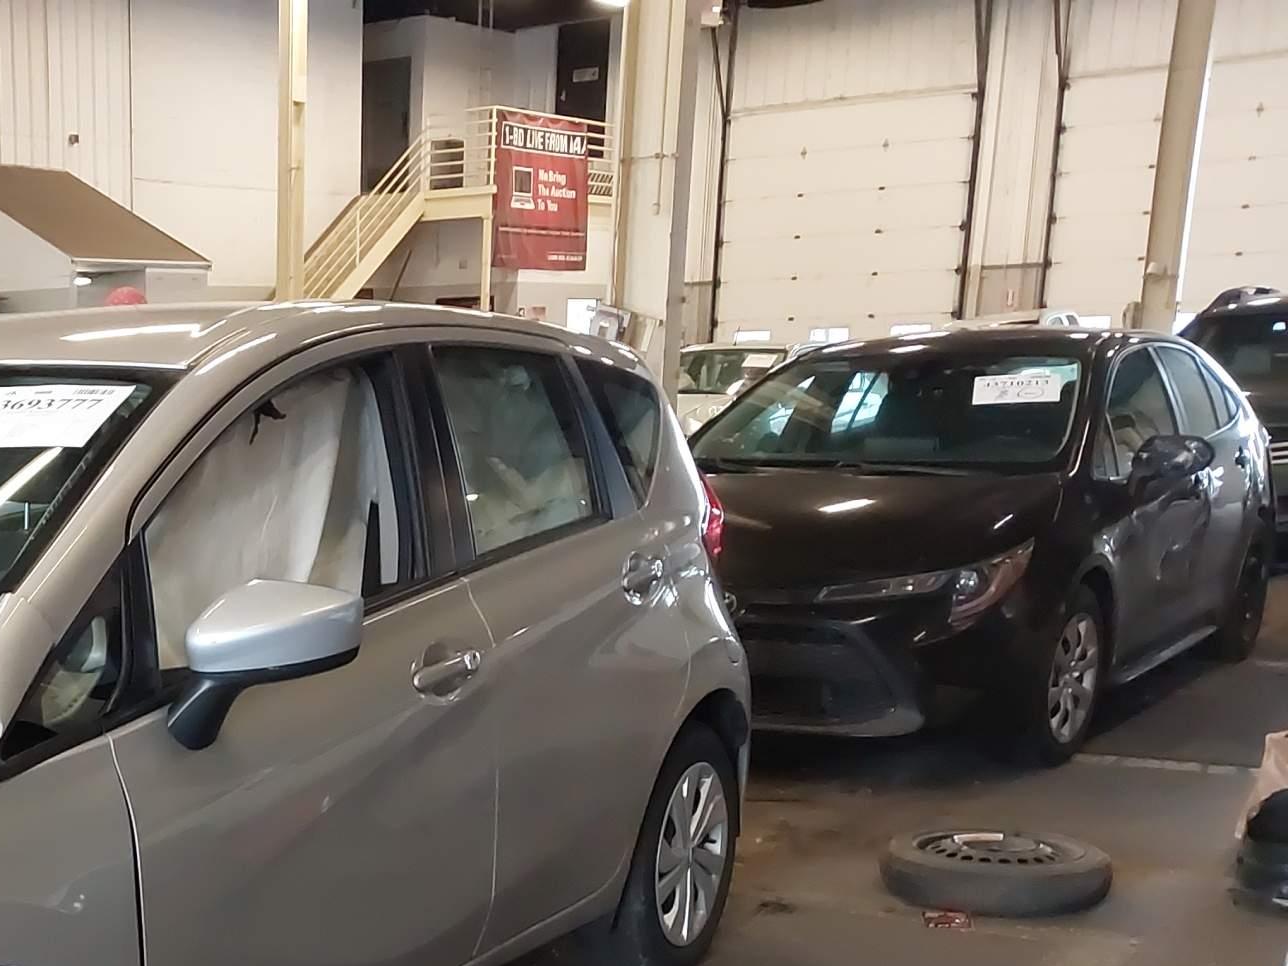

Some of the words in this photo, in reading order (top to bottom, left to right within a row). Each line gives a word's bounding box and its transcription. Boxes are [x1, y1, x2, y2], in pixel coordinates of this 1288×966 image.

[526, 129, 544, 150] LIVE
[545, 131, 568, 153] FROM
[549, 170, 567, 186] Bring
[551, 186, 576, 199] Auction
